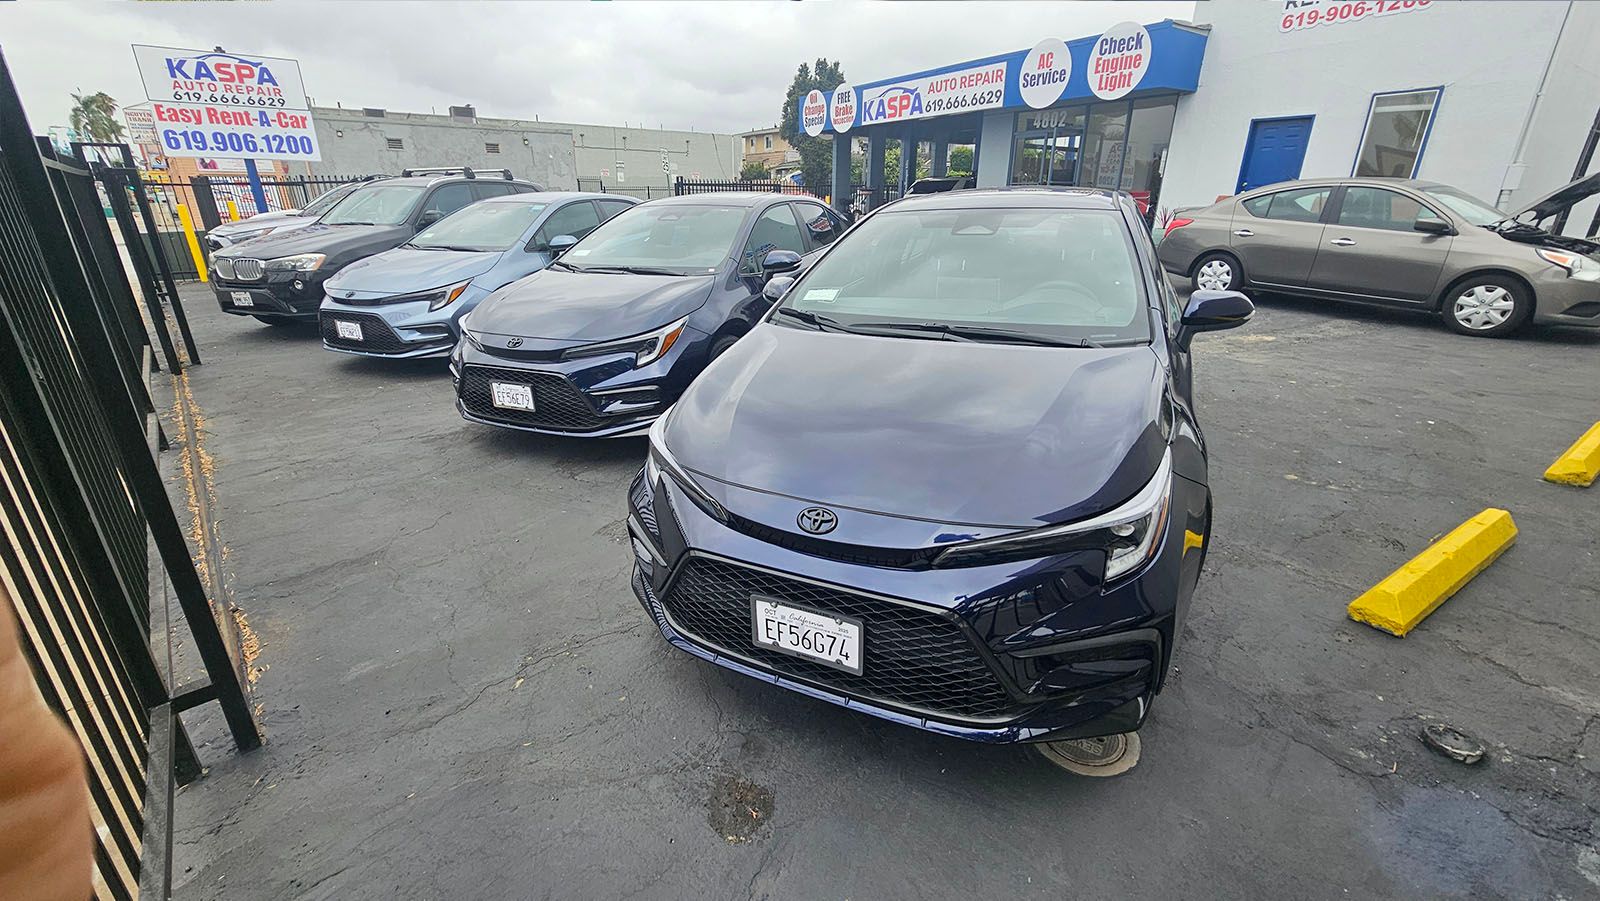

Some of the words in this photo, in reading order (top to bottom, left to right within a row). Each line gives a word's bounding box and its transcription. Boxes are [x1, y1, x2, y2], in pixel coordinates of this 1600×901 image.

[1099, 31, 1144, 56] Check
[1037, 52, 1054, 70] AC
[1094, 53, 1142, 75] Engine
[166, 58, 279, 87] KASPA
[928, 78, 957, 95] AUTO
[959, 68, 1004, 90] REPAIR
[1022, 68, 1066, 88] Service
[1098, 71, 1133, 91] Light
[172, 80, 218, 92] AUTO
[223, 83, 283, 97] REPAIR
[837, 91, 851, 104] FREE
[173, 91, 286, 107] 619.666.6629
[863, 92, 923, 122] KASPA
[925, 89, 1002, 113] 619.666.6629
[154, 104, 203, 125] Easy
[205, 107, 308, 129] Rent-A-Car
[805, 104, 824, 116] Change
[835, 104, 853, 117] Brake
[1033, 110, 1068, 129] 4802
[805, 114, 824, 127] Special
[163, 129, 314, 155] 619.906.1200
[497, 390, 529, 405] EF56E79
[789, 613, 824, 627] California
[765, 618, 850, 661] EF56G74
